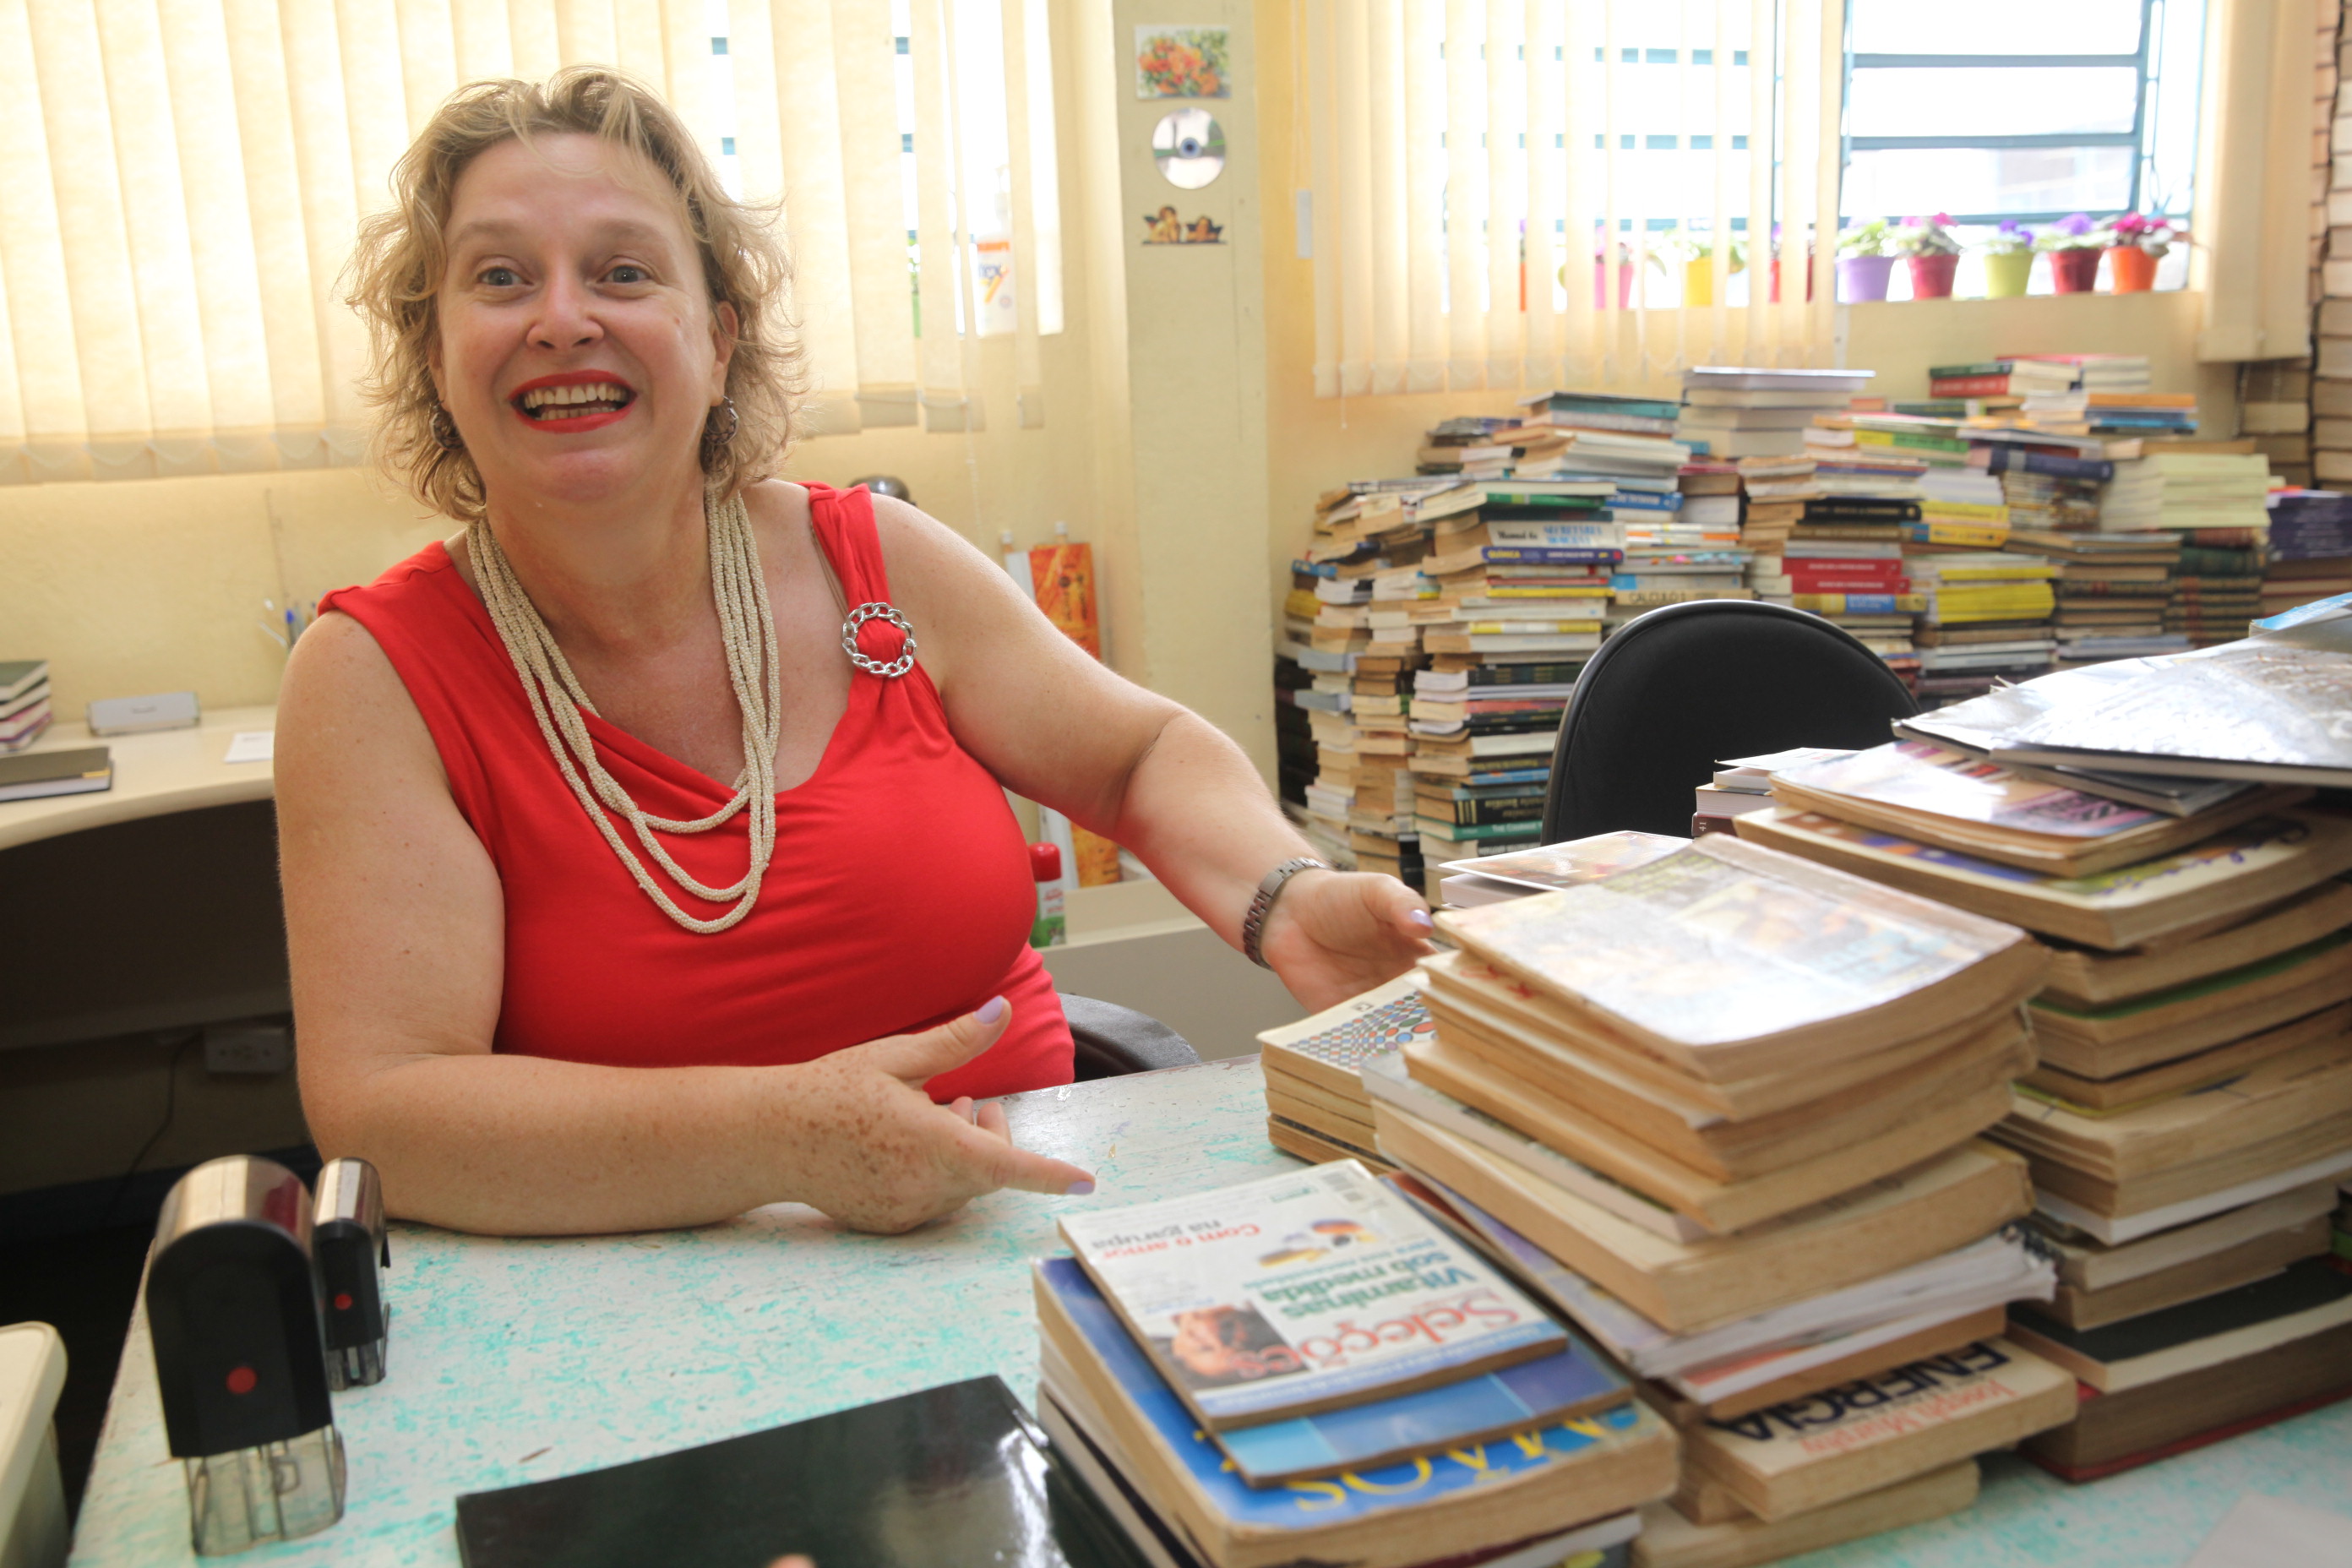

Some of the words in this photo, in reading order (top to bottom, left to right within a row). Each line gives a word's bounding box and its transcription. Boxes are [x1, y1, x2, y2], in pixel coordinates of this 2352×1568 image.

[1092, 1222, 1183, 1252] garupa
[1174, 1234, 1192, 1250] o
[1188, 1218, 1222, 1239] na
[1195, 1220, 1261, 1245] Com
[1101, 1237, 1170, 1263] amor
[1391, 1250, 1451, 1279] sob
[1261, 1259, 1386, 1305] medida
[1280, 1266, 1478, 1320] Vitaminas
[1229, 1294, 1519, 1380] Seleções
